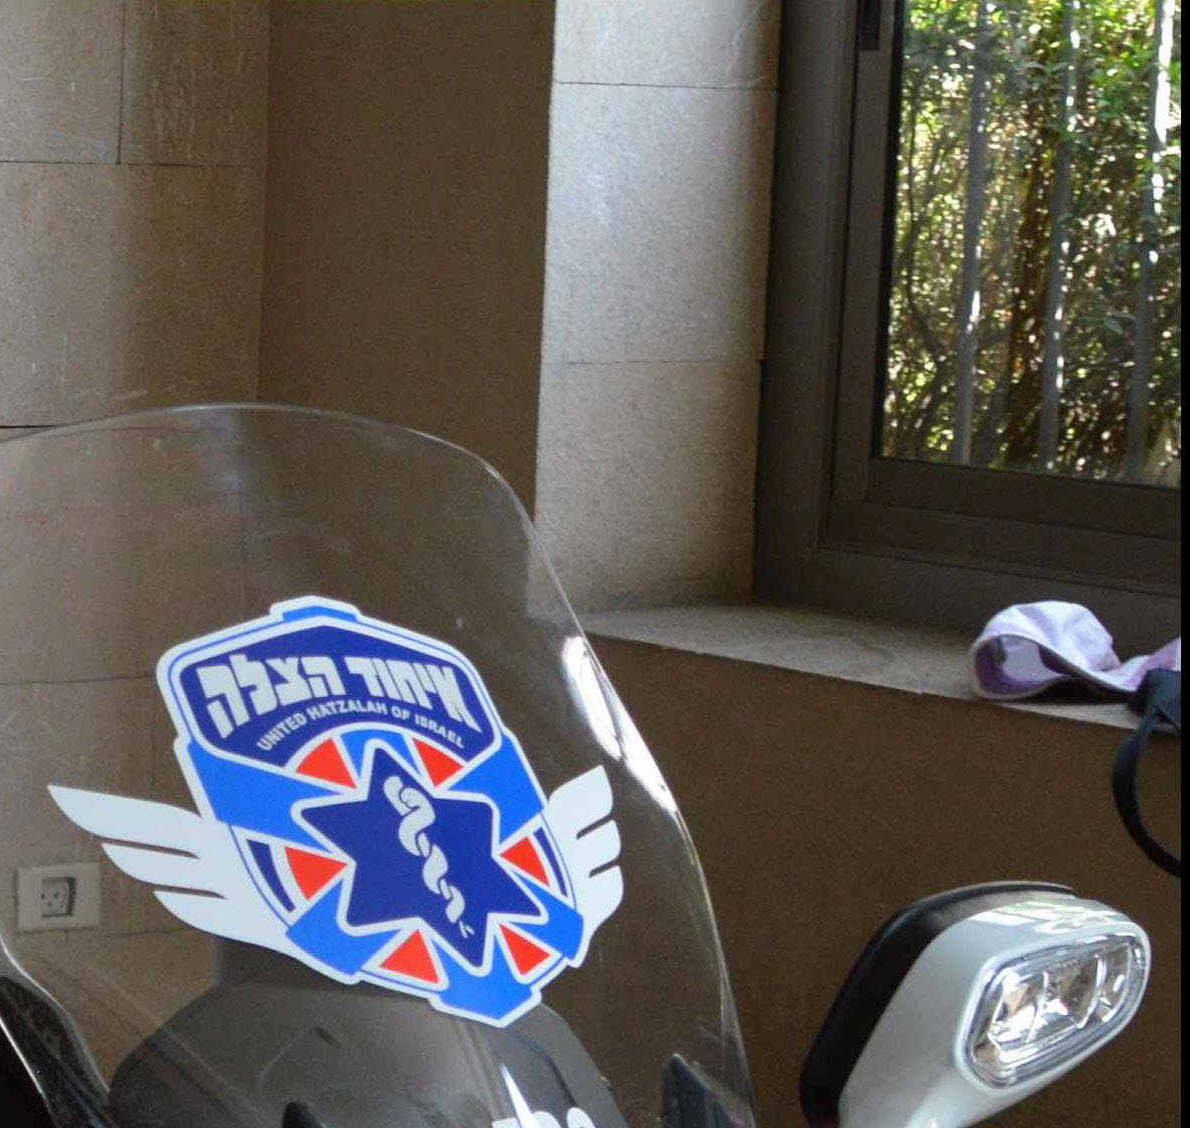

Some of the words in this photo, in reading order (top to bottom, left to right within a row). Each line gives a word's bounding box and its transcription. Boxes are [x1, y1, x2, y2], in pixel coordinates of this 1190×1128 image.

[196, 653, 346, 739] הצלה
[256, 711, 308, 752] UNITED
[305, 699, 388, 721] HATZALAH
[391, 705, 411, 721] OF
[414, 713, 466, 749] ISRAEL
[344, 656, 482, 733] איחוד
